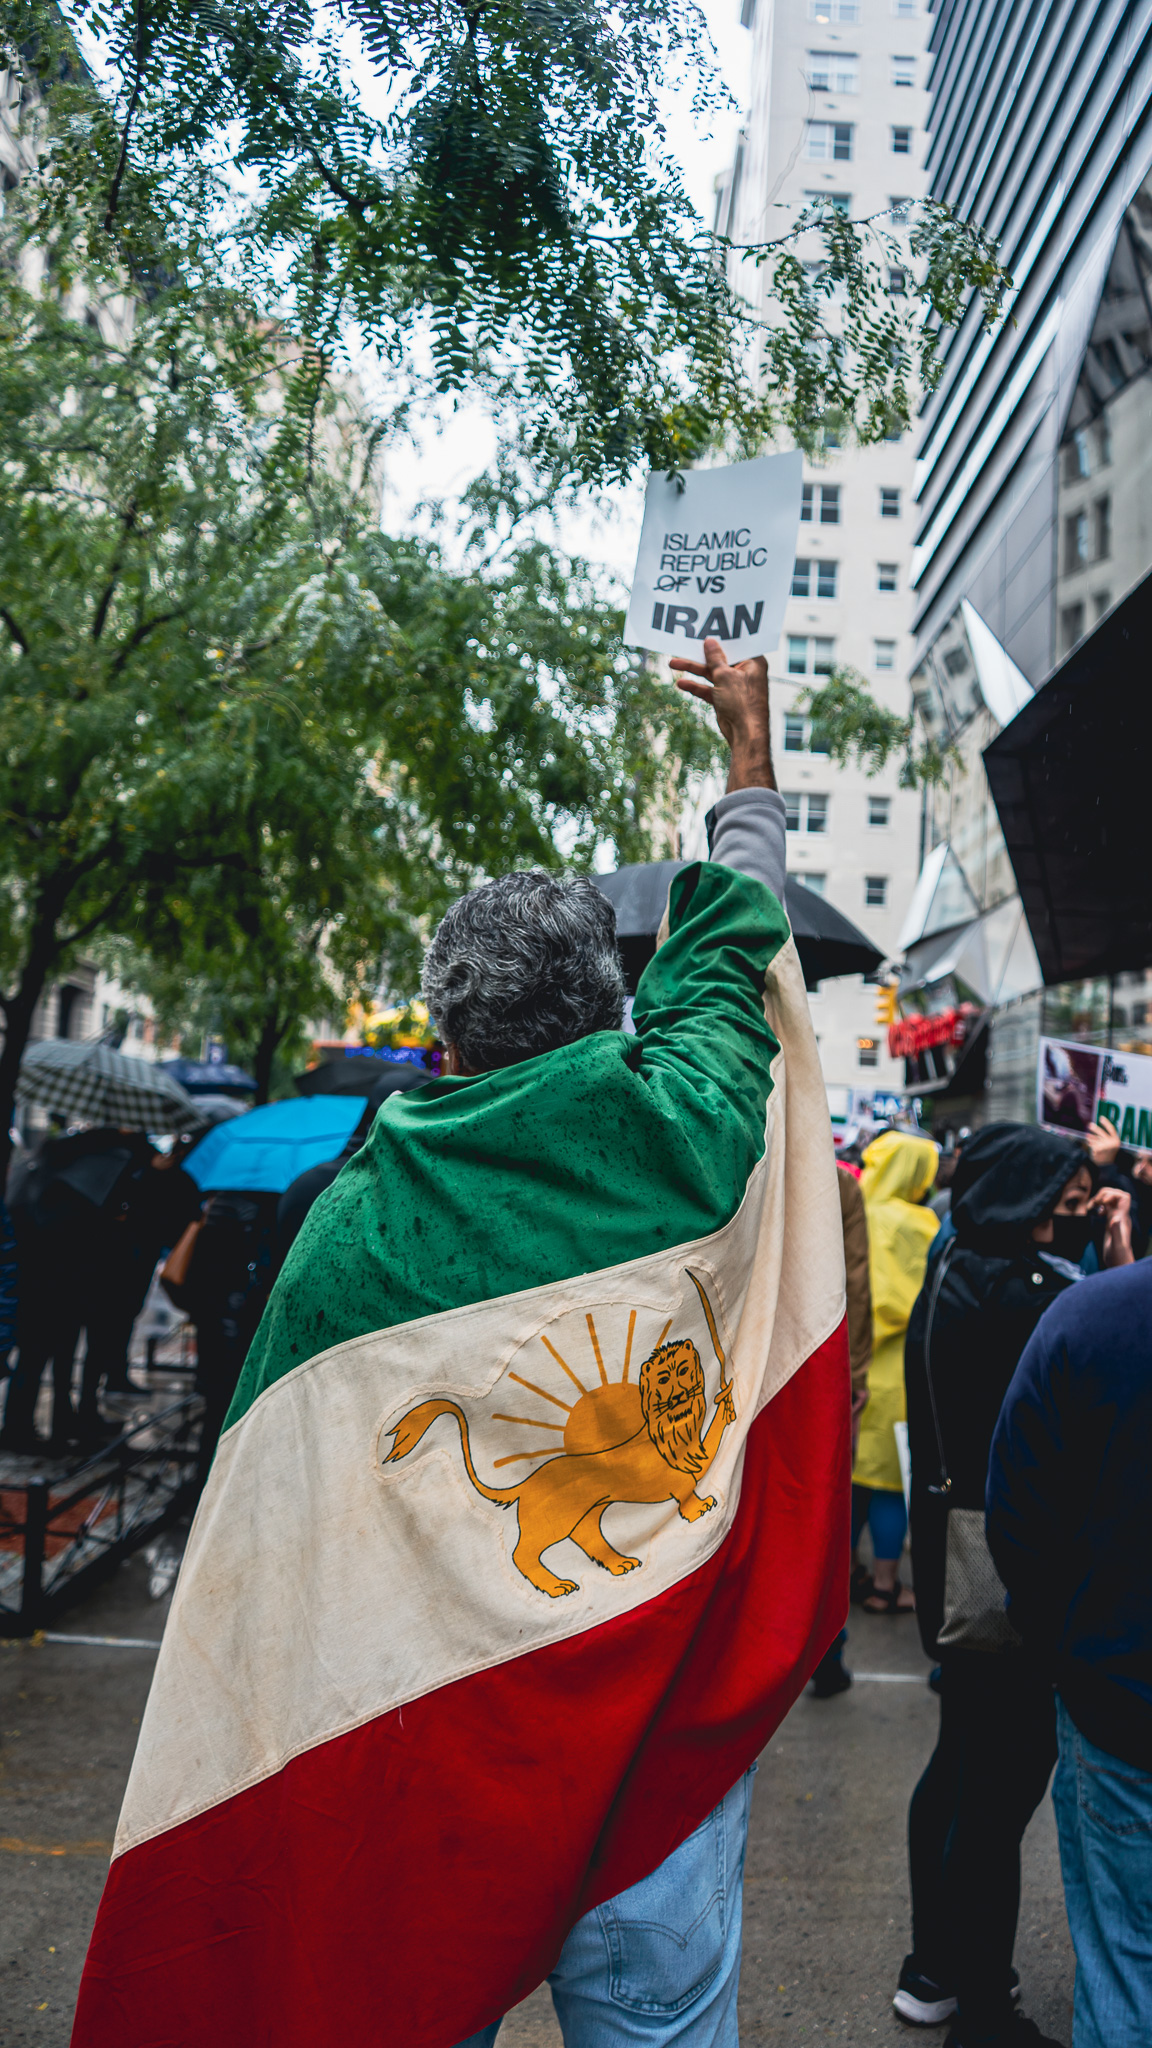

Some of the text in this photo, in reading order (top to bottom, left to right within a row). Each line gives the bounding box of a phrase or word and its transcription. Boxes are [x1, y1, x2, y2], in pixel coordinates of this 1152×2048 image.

[662, 528, 751, 551] ISLAMIC
[660, 548, 767, 572] REPUBLIC
[655, 575, 726, 594] OF VS
[652, 601, 764, 640] IRAN
